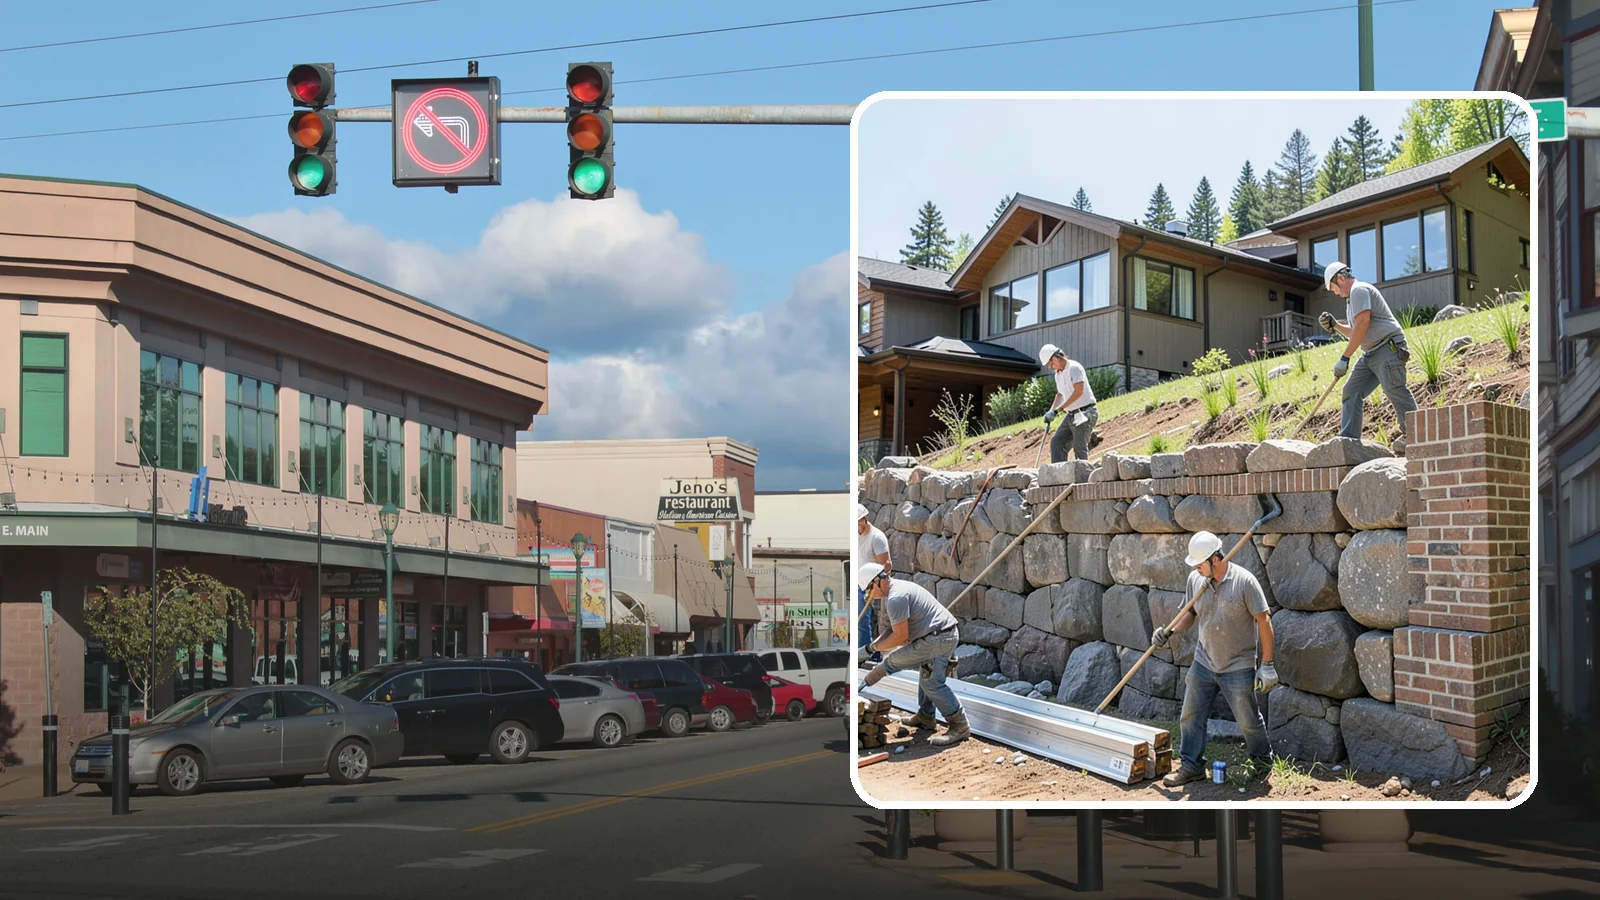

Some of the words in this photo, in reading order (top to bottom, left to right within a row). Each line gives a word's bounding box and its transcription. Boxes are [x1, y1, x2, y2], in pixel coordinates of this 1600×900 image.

[669, 479, 728, 495] Jeno's
[665, 496, 731, 509] restaurant
[658, 510, 682, 520] Italian
[686, 510, 714, 519] American
[715, 509, 738, 519] Cuisine
[2, 525, 13, 536] E.
[15, 525, 49, 536] MAIN
[785, 607, 795, 617] in
[797, 607, 829, 617] Street
[788, 619, 824, 627] lass
